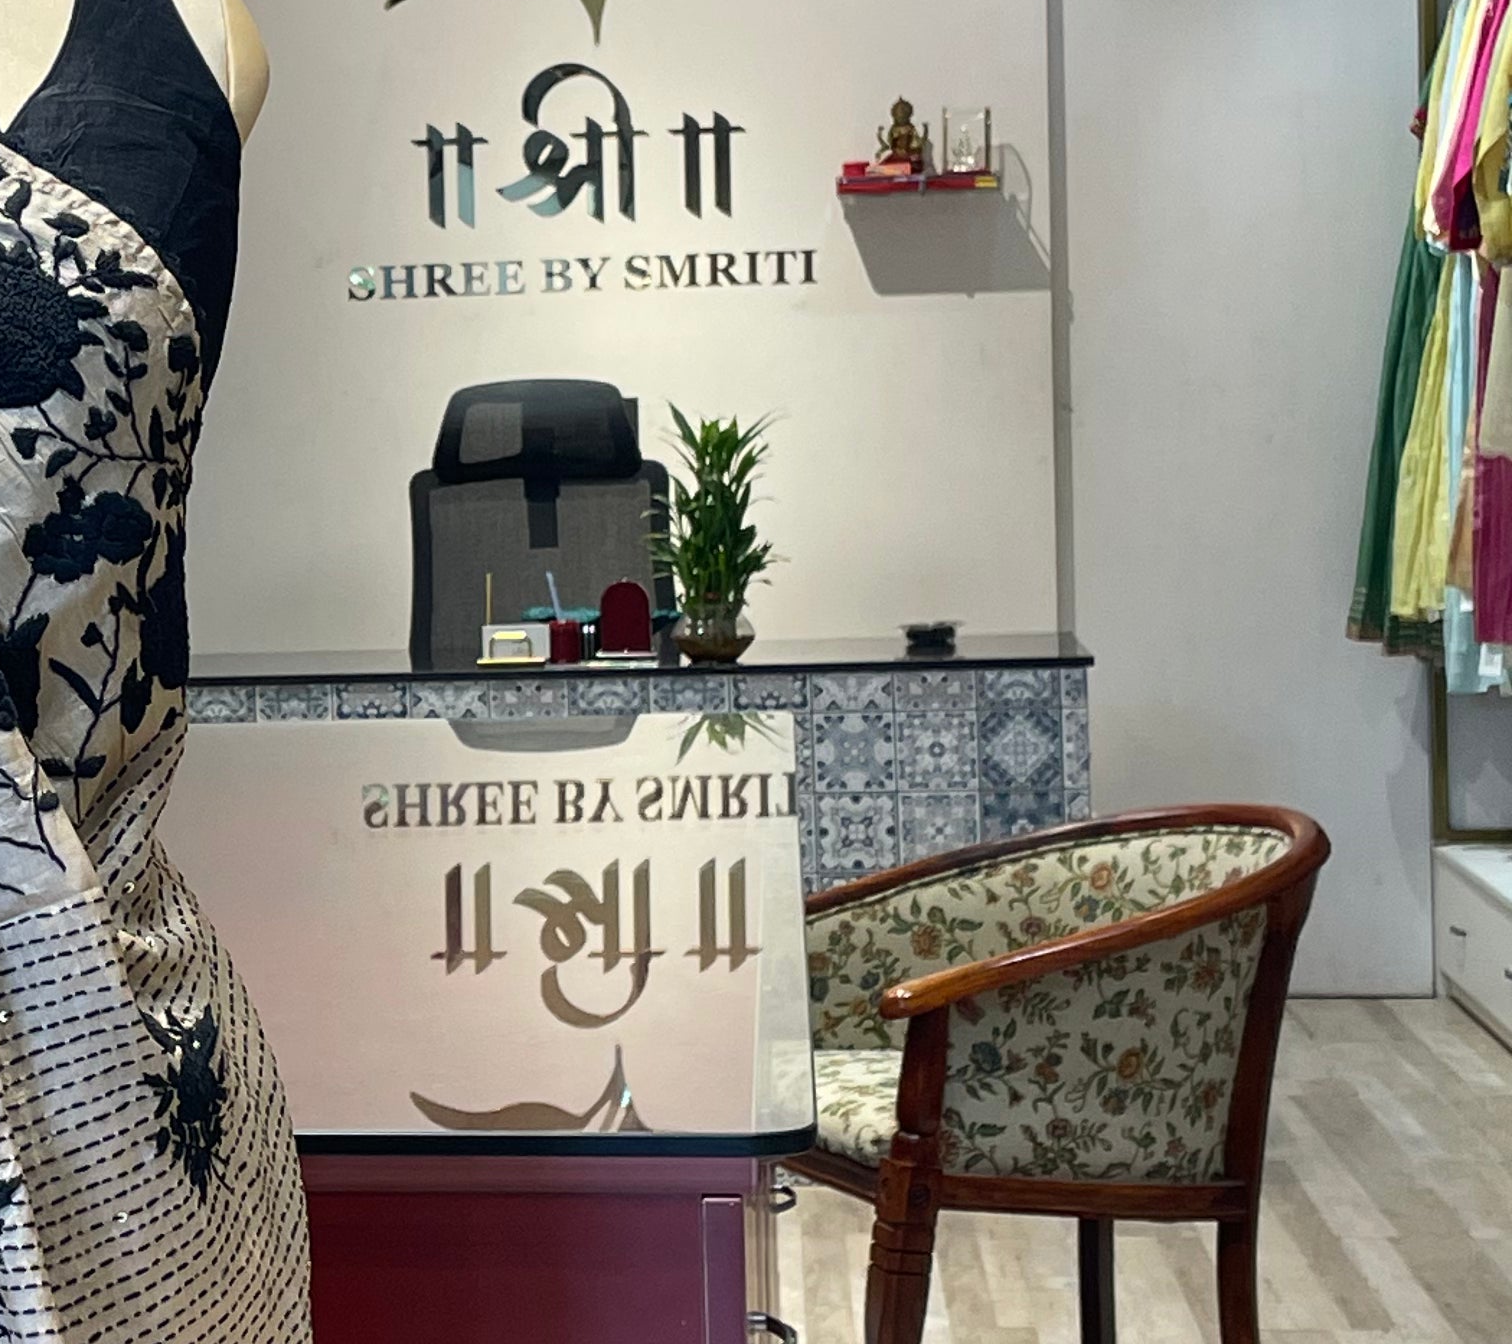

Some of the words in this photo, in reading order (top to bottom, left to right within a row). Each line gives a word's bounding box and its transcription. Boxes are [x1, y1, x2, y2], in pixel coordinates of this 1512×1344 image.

[347, 260, 526, 302] SHREE
[540, 256, 611, 295] BY
[624, 249, 819, 292] SMRITI
